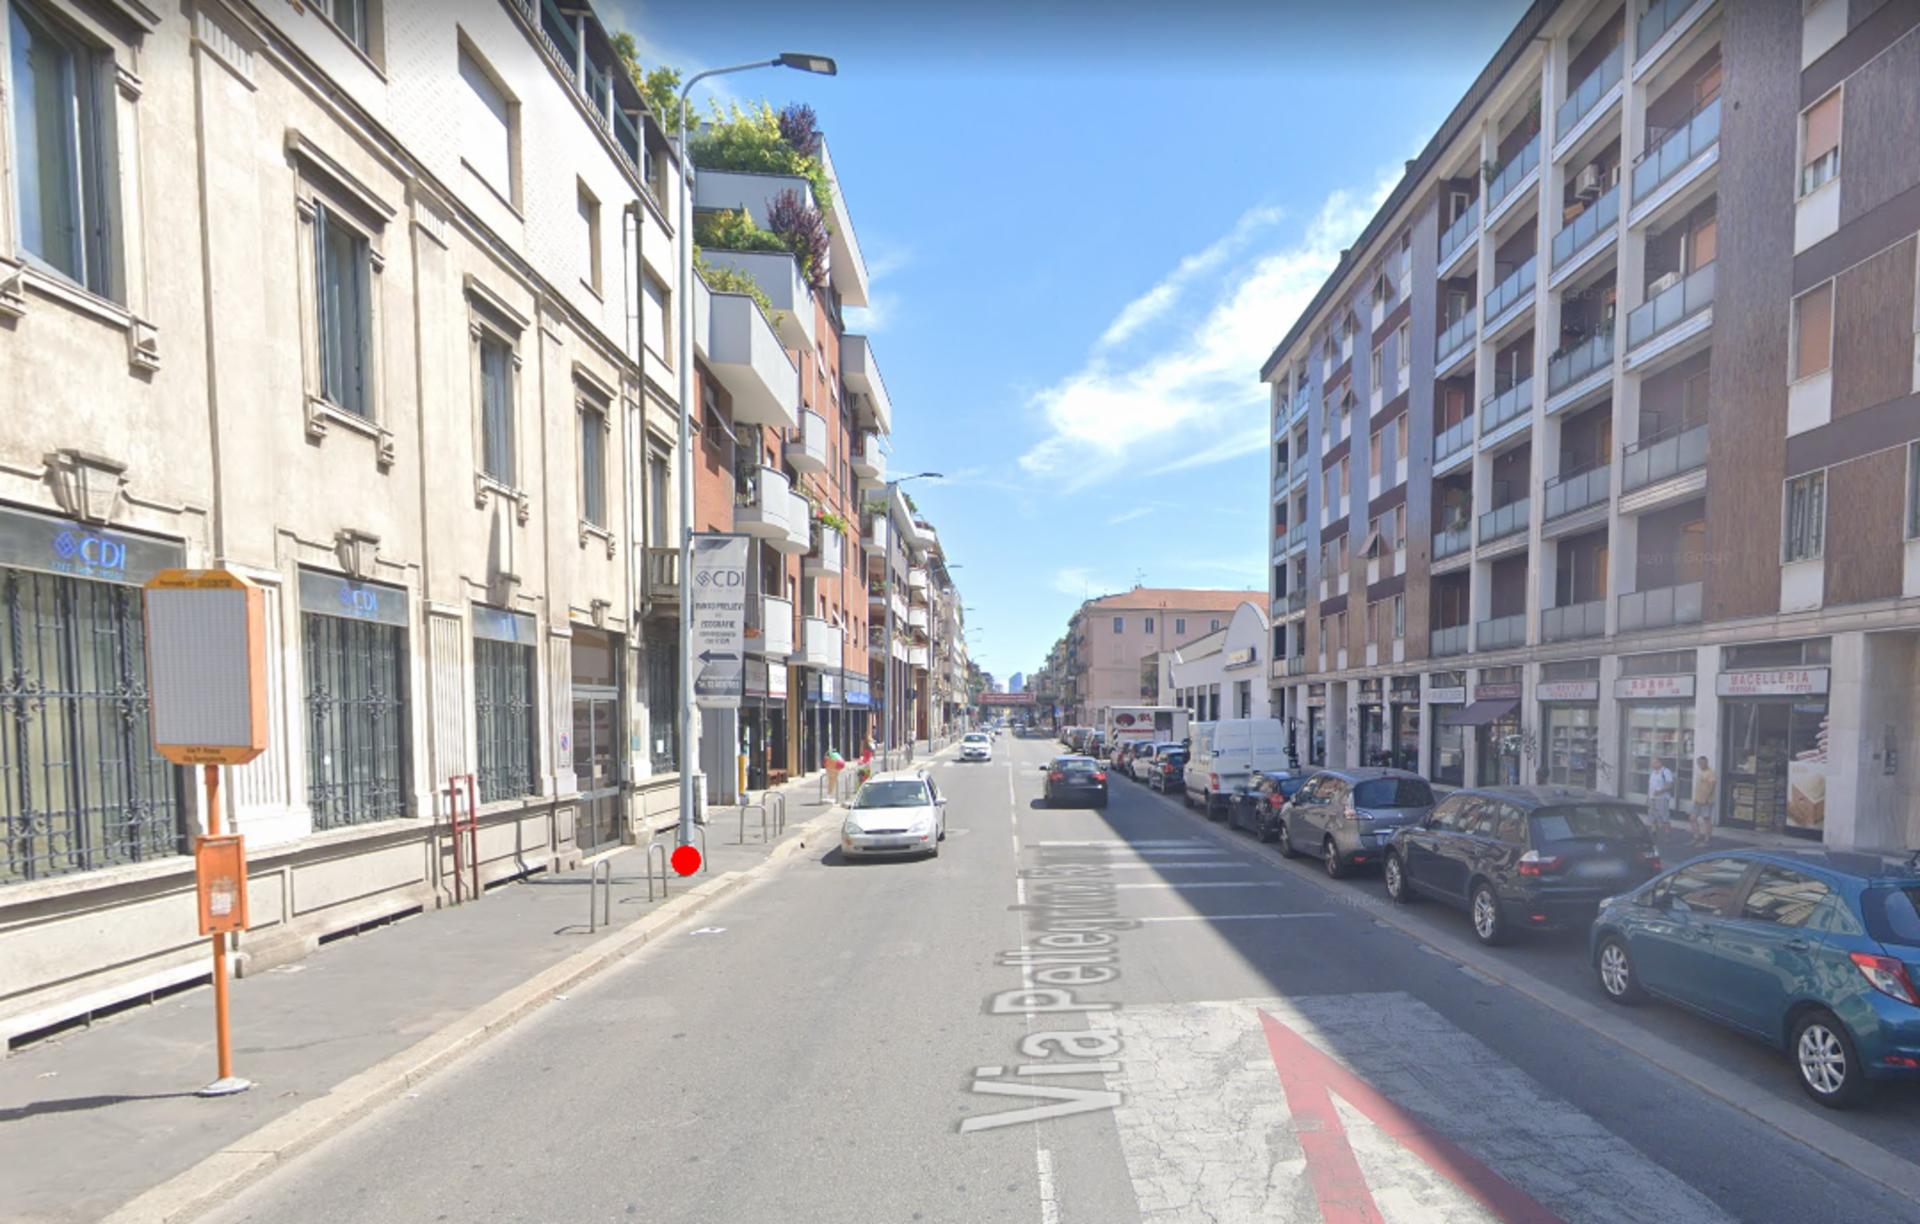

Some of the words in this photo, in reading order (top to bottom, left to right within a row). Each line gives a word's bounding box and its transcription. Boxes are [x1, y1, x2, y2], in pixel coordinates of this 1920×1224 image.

[79, 537, 127, 570] CDI
[712, 570, 745, 587] CDI
[352, 590, 378, 611] CDI
[1730, 672, 1809, 685] MACELLERIA
